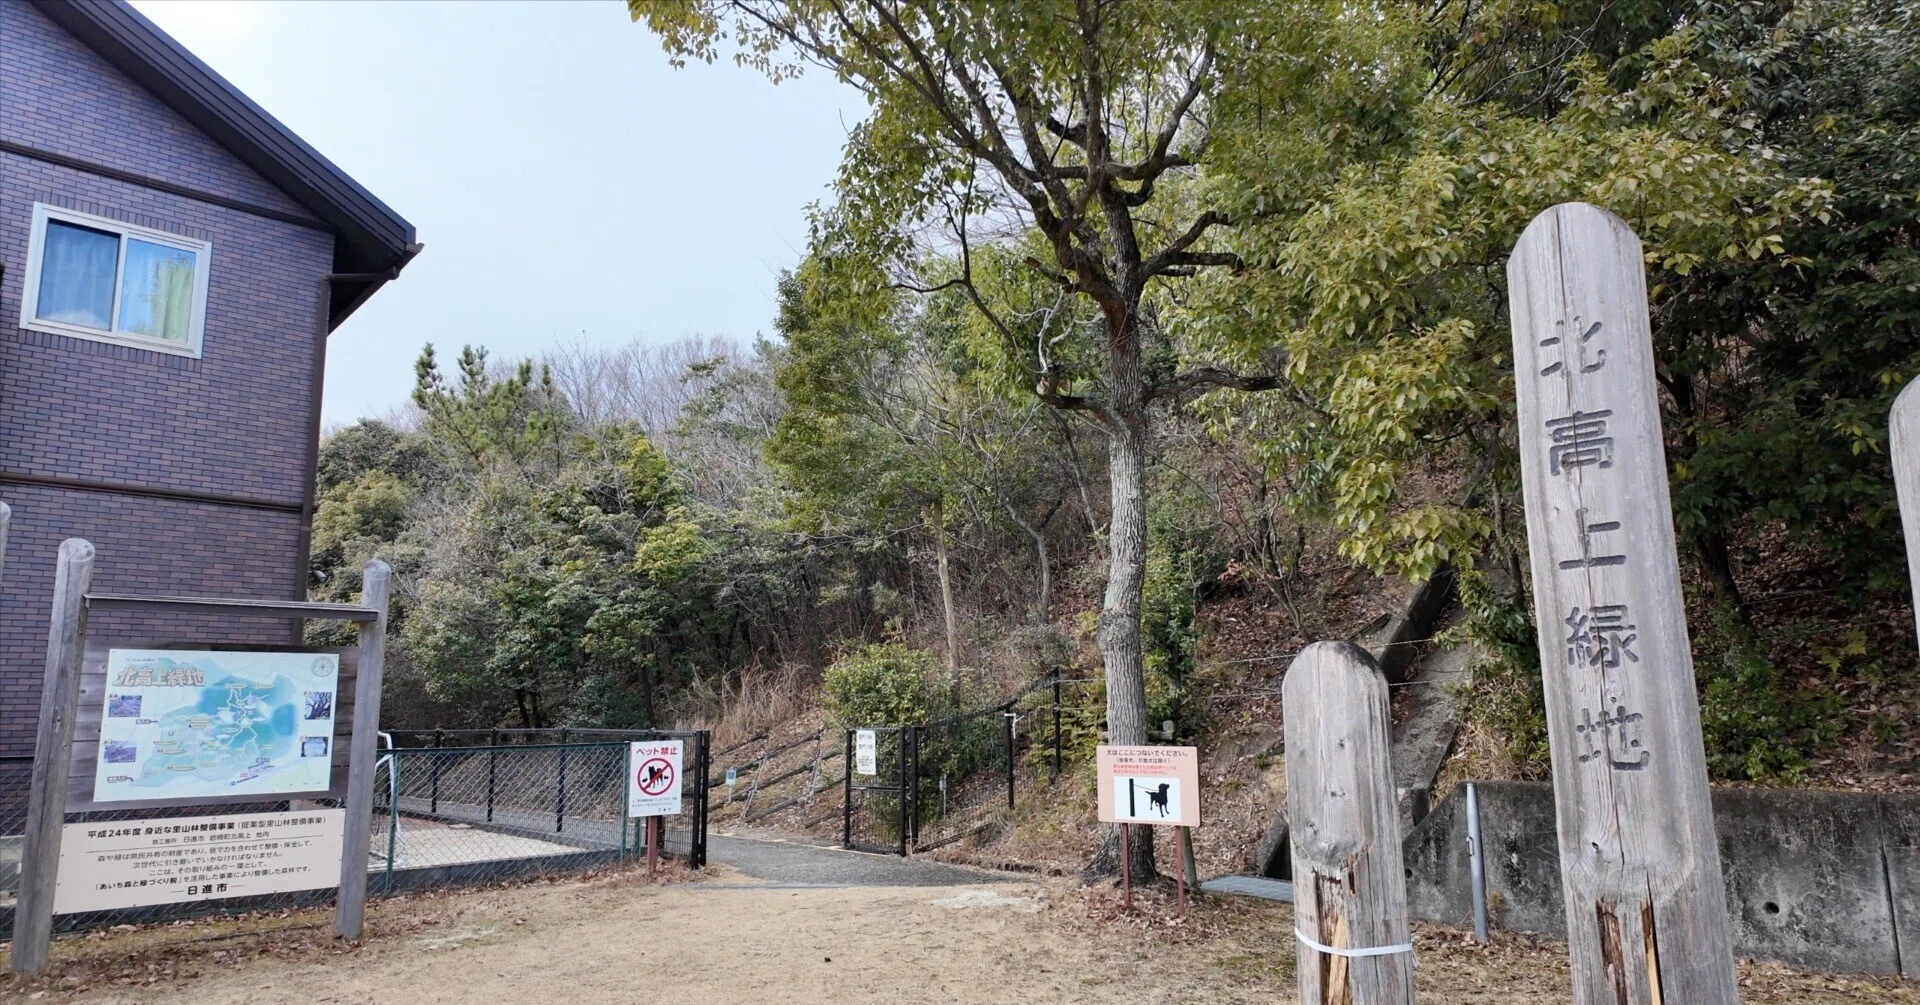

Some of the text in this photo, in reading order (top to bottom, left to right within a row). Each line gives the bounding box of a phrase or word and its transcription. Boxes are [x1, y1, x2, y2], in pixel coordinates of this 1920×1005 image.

[1538, 315, 1651, 772] 北高上緑地
[113, 666, 206, 688] 北高上緑地
[636, 746, 678, 756] ペット禁止
[1106, 749, 1188, 757] 犬はここにつないでください。
[87, 827, 142, 839] 平成24年度
[183, 835, 205, 843] 日進市
[187, 882, 228, 896] 日進市
